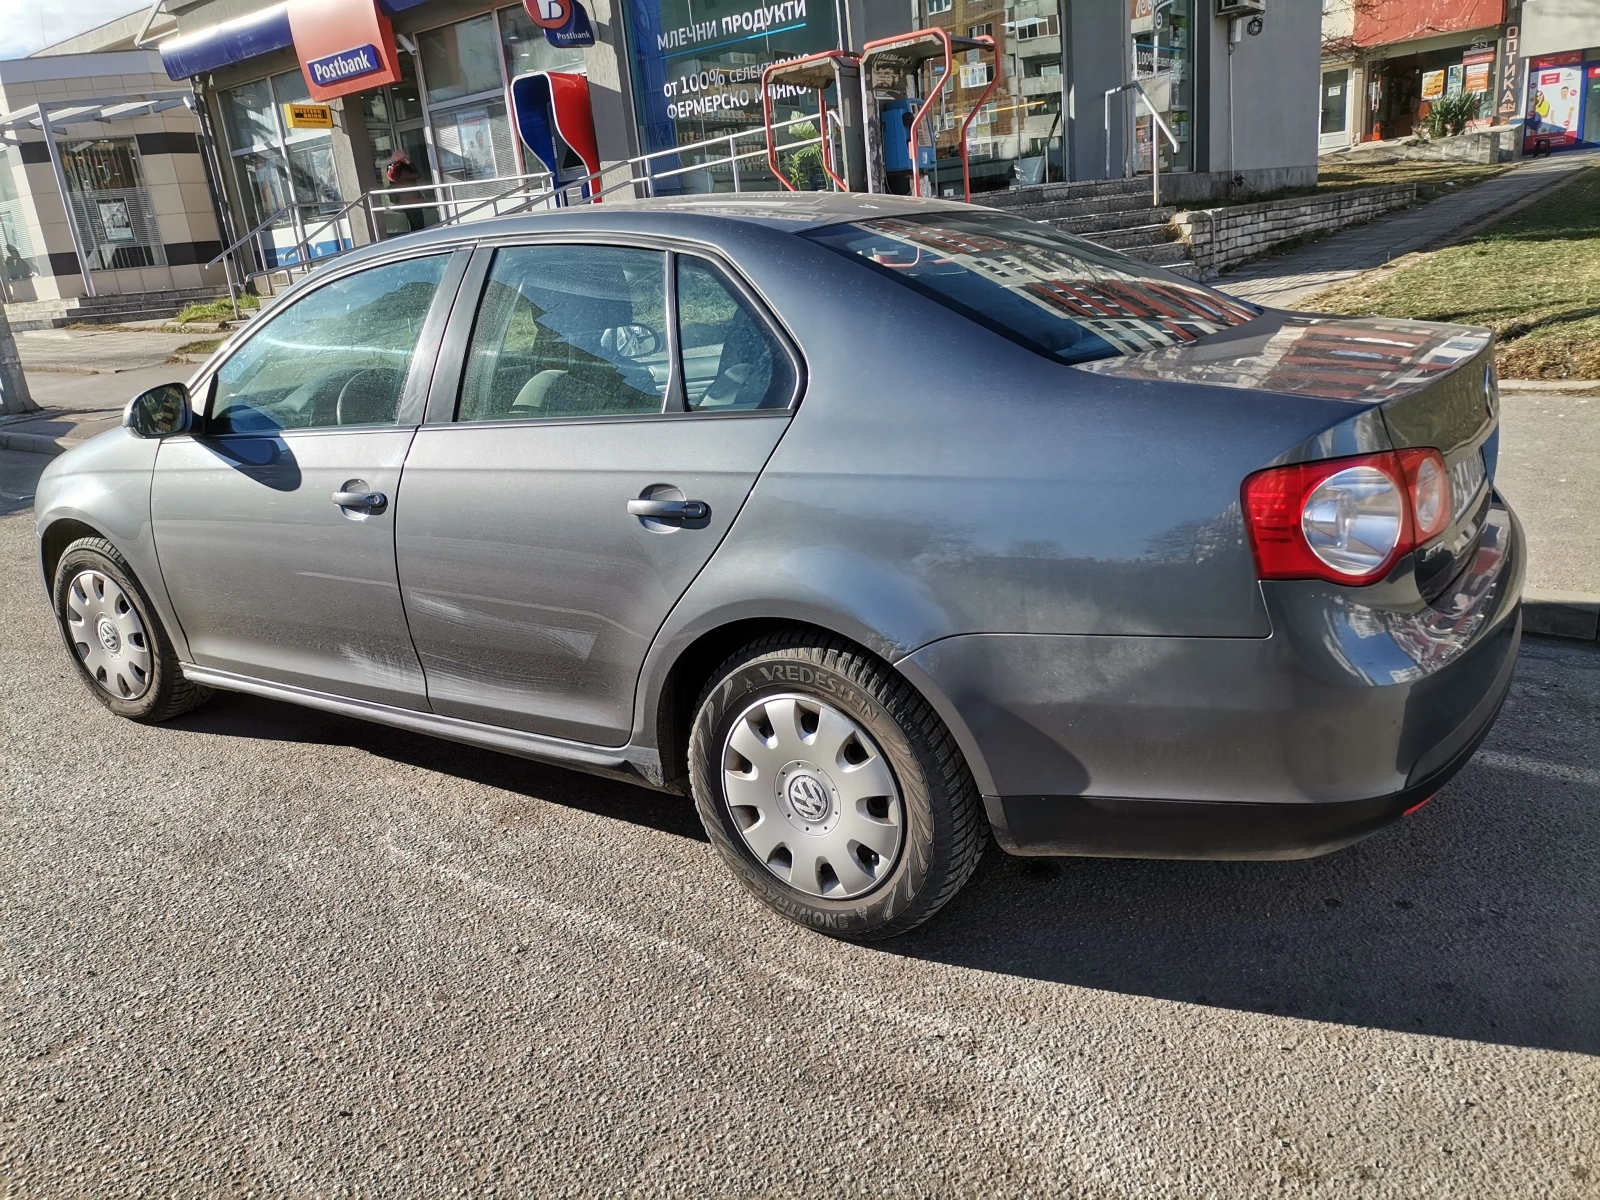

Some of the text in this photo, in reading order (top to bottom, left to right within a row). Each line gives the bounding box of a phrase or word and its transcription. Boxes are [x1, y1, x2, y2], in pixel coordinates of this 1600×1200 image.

[556, 30, 591, 40] Postbank
[657, 0, 807, 51] МЛЕЧНИ ПРОДУКТИ
[313, 50, 371, 81] Postbank
[680, 68, 726, 94] 100%
[1502, 25, 1519, 103] ОПТИКА
[667, 89, 750, 120] ФЕРМЕРСКО
[759, 665, 880, 723] VREDESTEIN
[756, 881, 850, 930] SNOWTRAC
